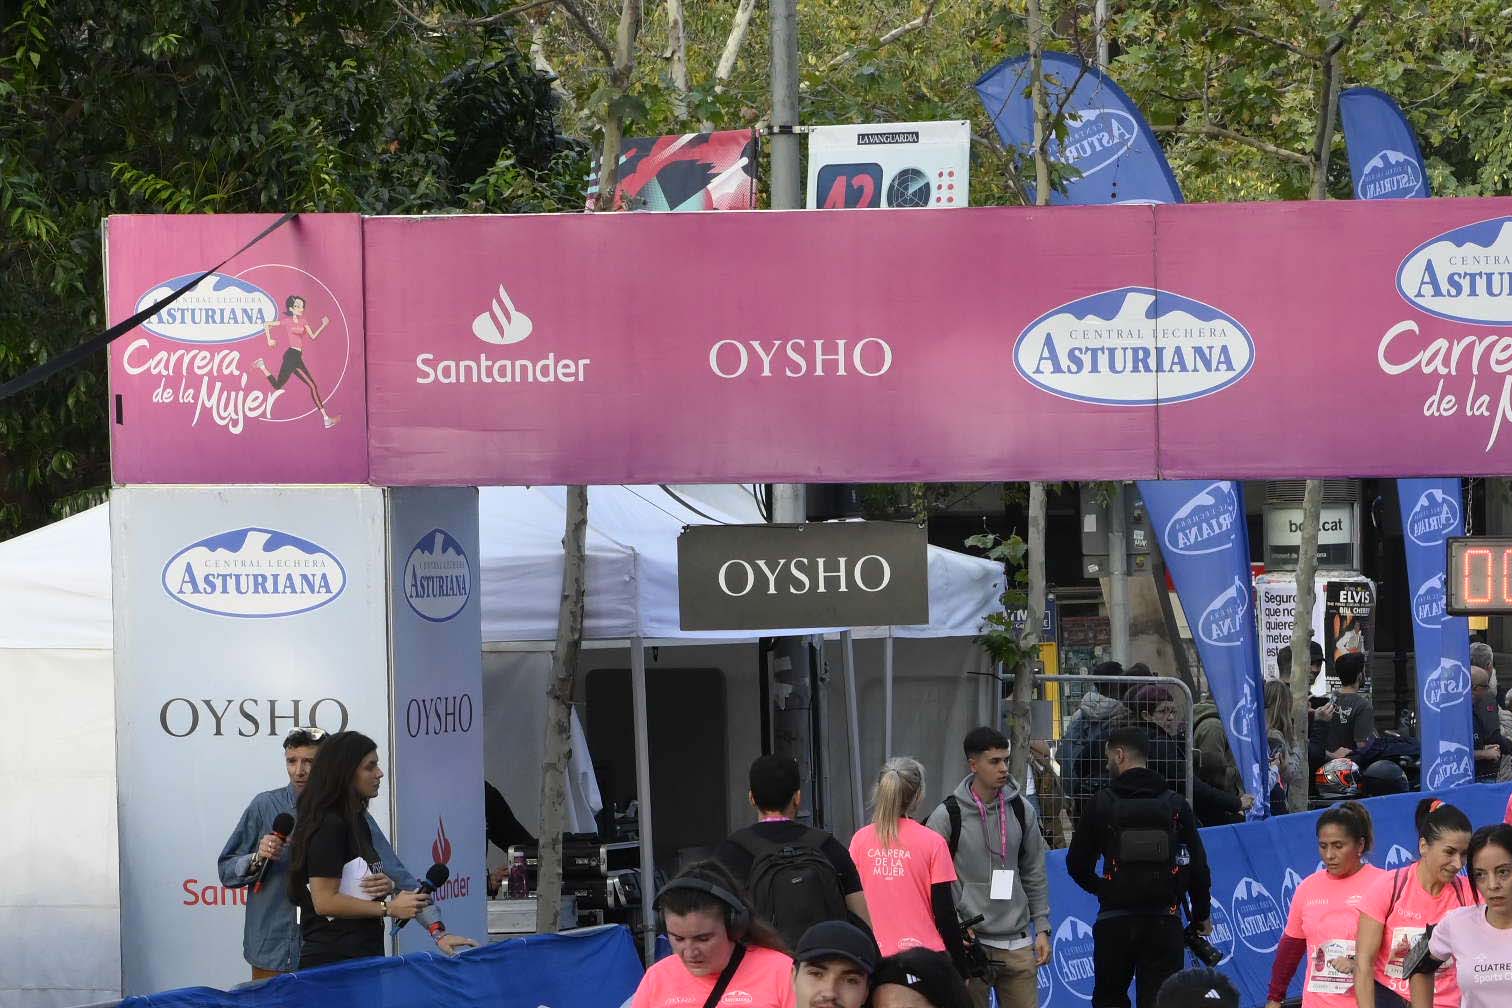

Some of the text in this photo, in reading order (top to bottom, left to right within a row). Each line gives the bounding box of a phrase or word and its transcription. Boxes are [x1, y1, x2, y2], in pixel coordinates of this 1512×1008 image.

[870, 133, 918, 144] VANGUARDIA
[146, 299, 267, 325] ASTURIANA
[175, 296, 213, 304] ENTRAL
[1069, 327, 1228, 340] CENTRAL LECHERA
[123, 338, 241, 376] Carrera
[709, 337, 893, 379] OYSHO
[1033, 332, 1236, 375] ASTURIANA
[416, 352, 590, 384] Santander
[152, 373, 285, 434] de la Mujer
[1423, 378, 1457, 417] de
[1466, 376, 1491, 417] la
[1289, 519, 1343, 532] b.cat
[204, 559, 326, 568] CENTRAL LECHERA
[718, 555, 892, 596] OYSHO
[177, 561, 333, 595] ASTURIANA
[409, 564, 467, 600] ASTURIANA
[1339, 590, 1370, 603] ELVIS
[1265, 605, 1281, 617] que
[159, 697, 350, 738] OYSHO
[407, 693, 473, 738] OYSHO
[867, 848, 912, 859] CARRERA
[875, 858, 903, 867] DE LA
[873, 867, 904, 877] MUJER
[1473, 973, 1503, 984] Sports
